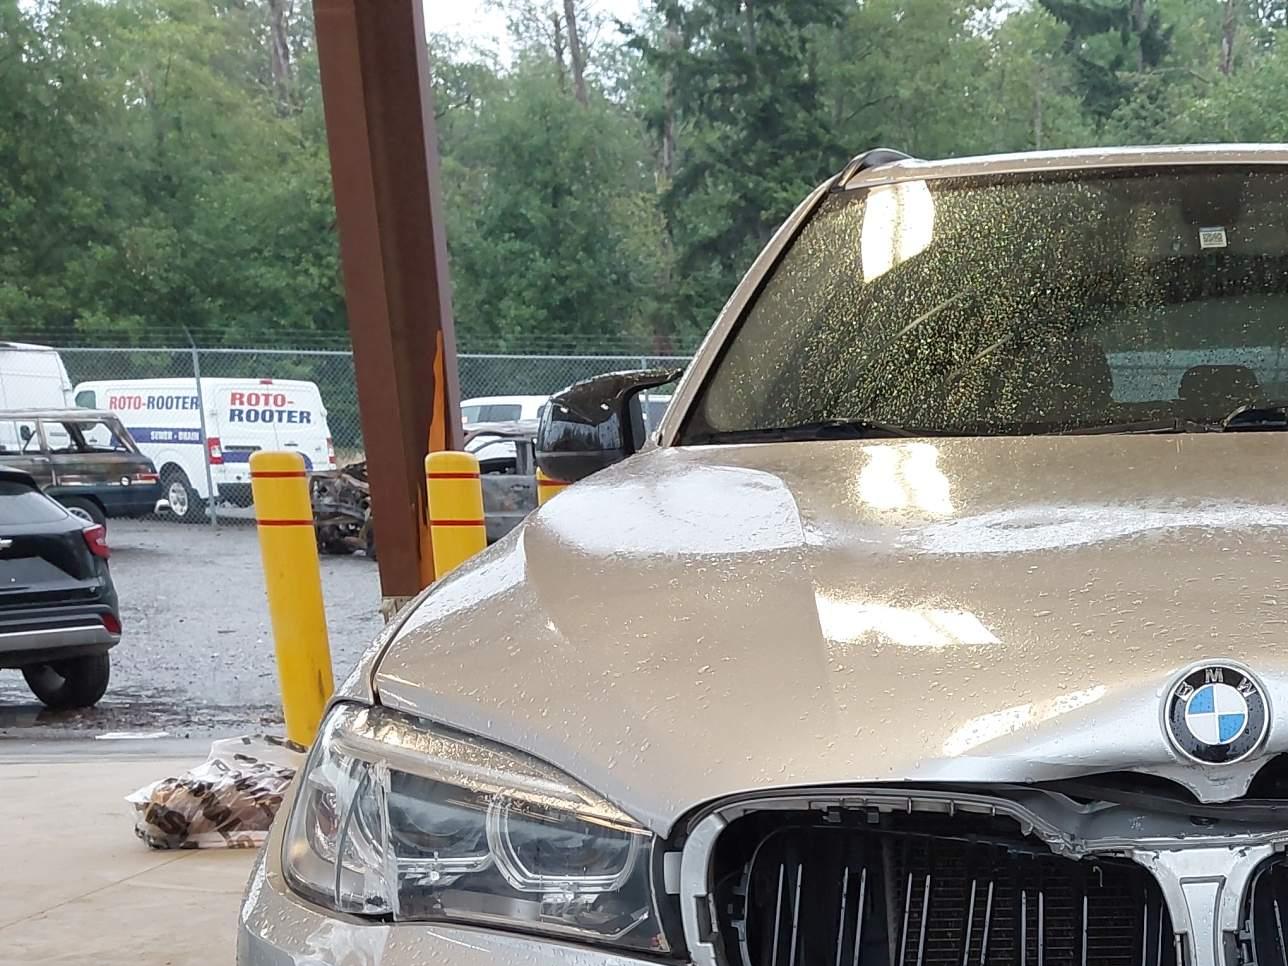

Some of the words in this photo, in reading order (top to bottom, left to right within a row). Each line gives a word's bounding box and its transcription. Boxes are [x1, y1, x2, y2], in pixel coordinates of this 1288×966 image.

[109, 395, 200, 411] ROTO-ROOTER
[230, 392, 295, 407] ROTO-
[229, 408, 312, 424] ROOTER
[1176, 668, 1256, 701] BMW
